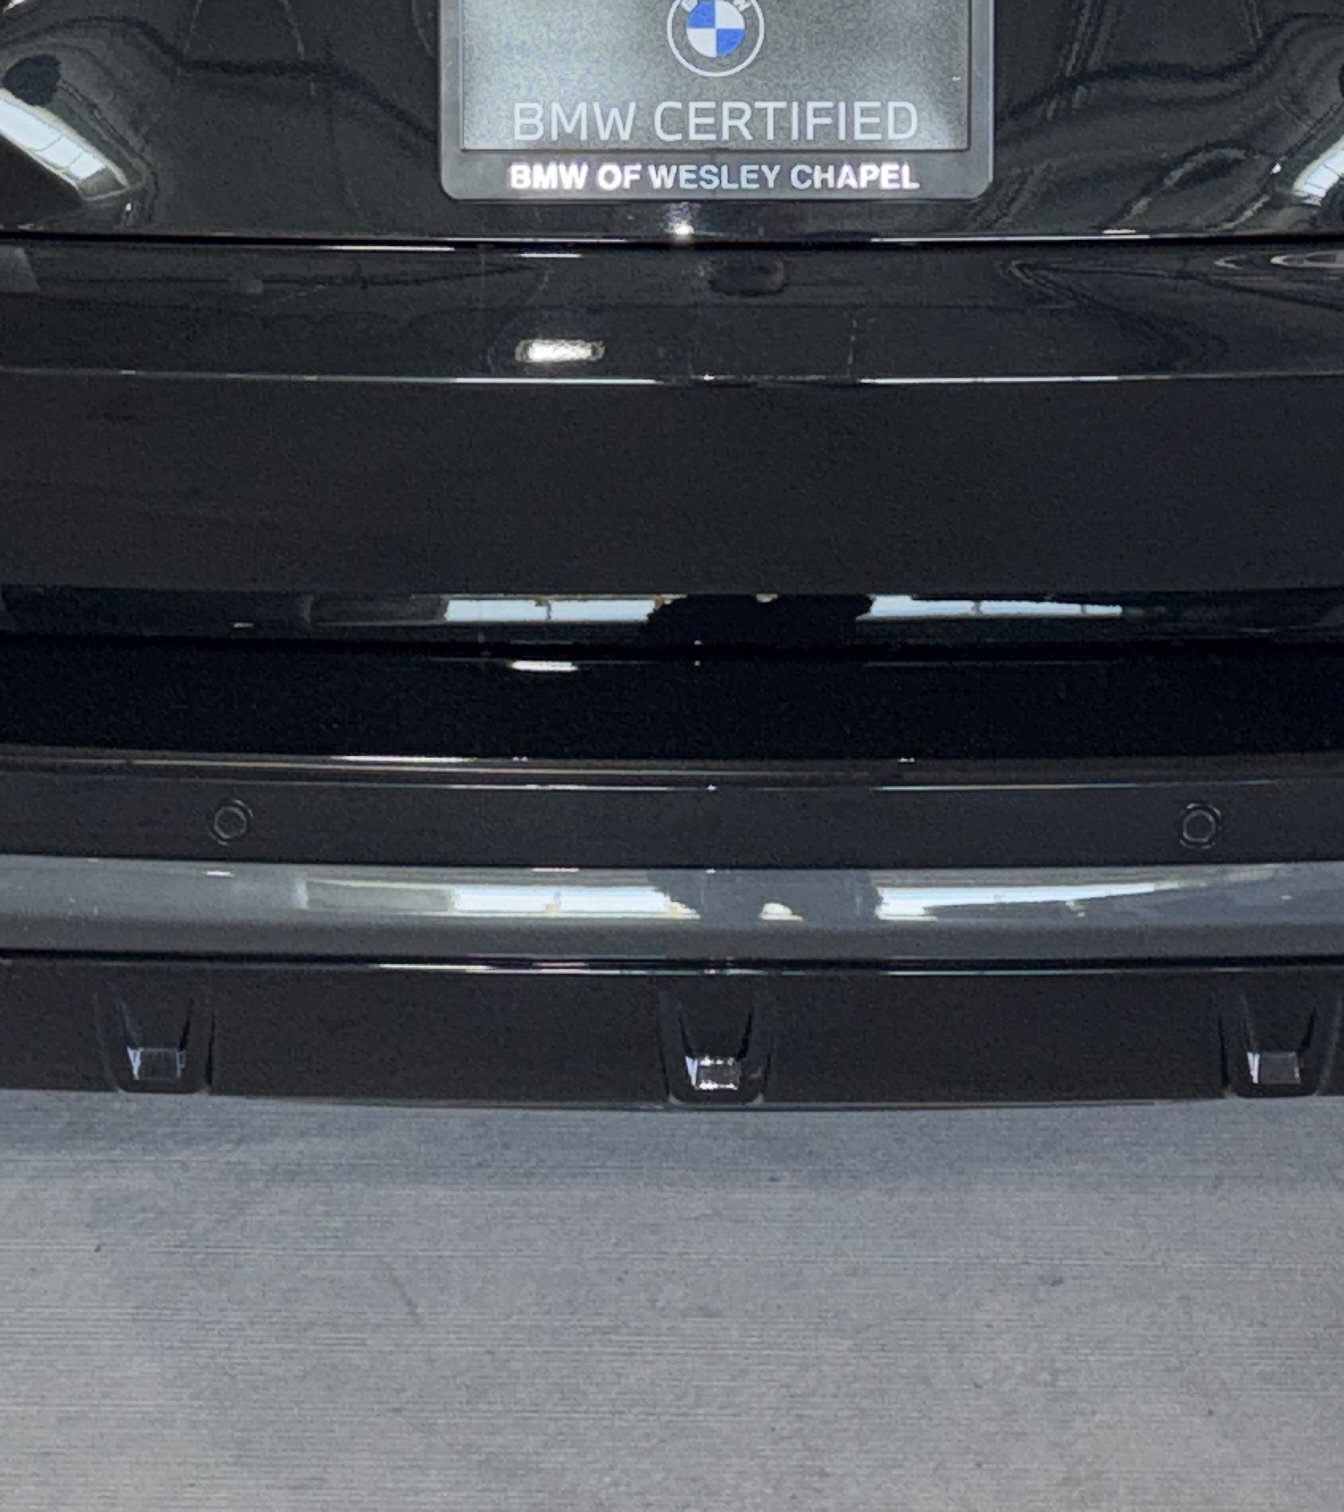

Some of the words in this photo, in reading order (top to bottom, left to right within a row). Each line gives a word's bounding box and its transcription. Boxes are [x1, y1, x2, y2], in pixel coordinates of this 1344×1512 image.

[513, 101, 637, 141] BMW
[654, 101, 918, 141] CERTIFIED
[510, 163, 589, 190] BMW
[597, 163, 642, 190] OF
[648, 163, 781, 190] WESLEY
[790, 163, 921, 190] CHAPEL
